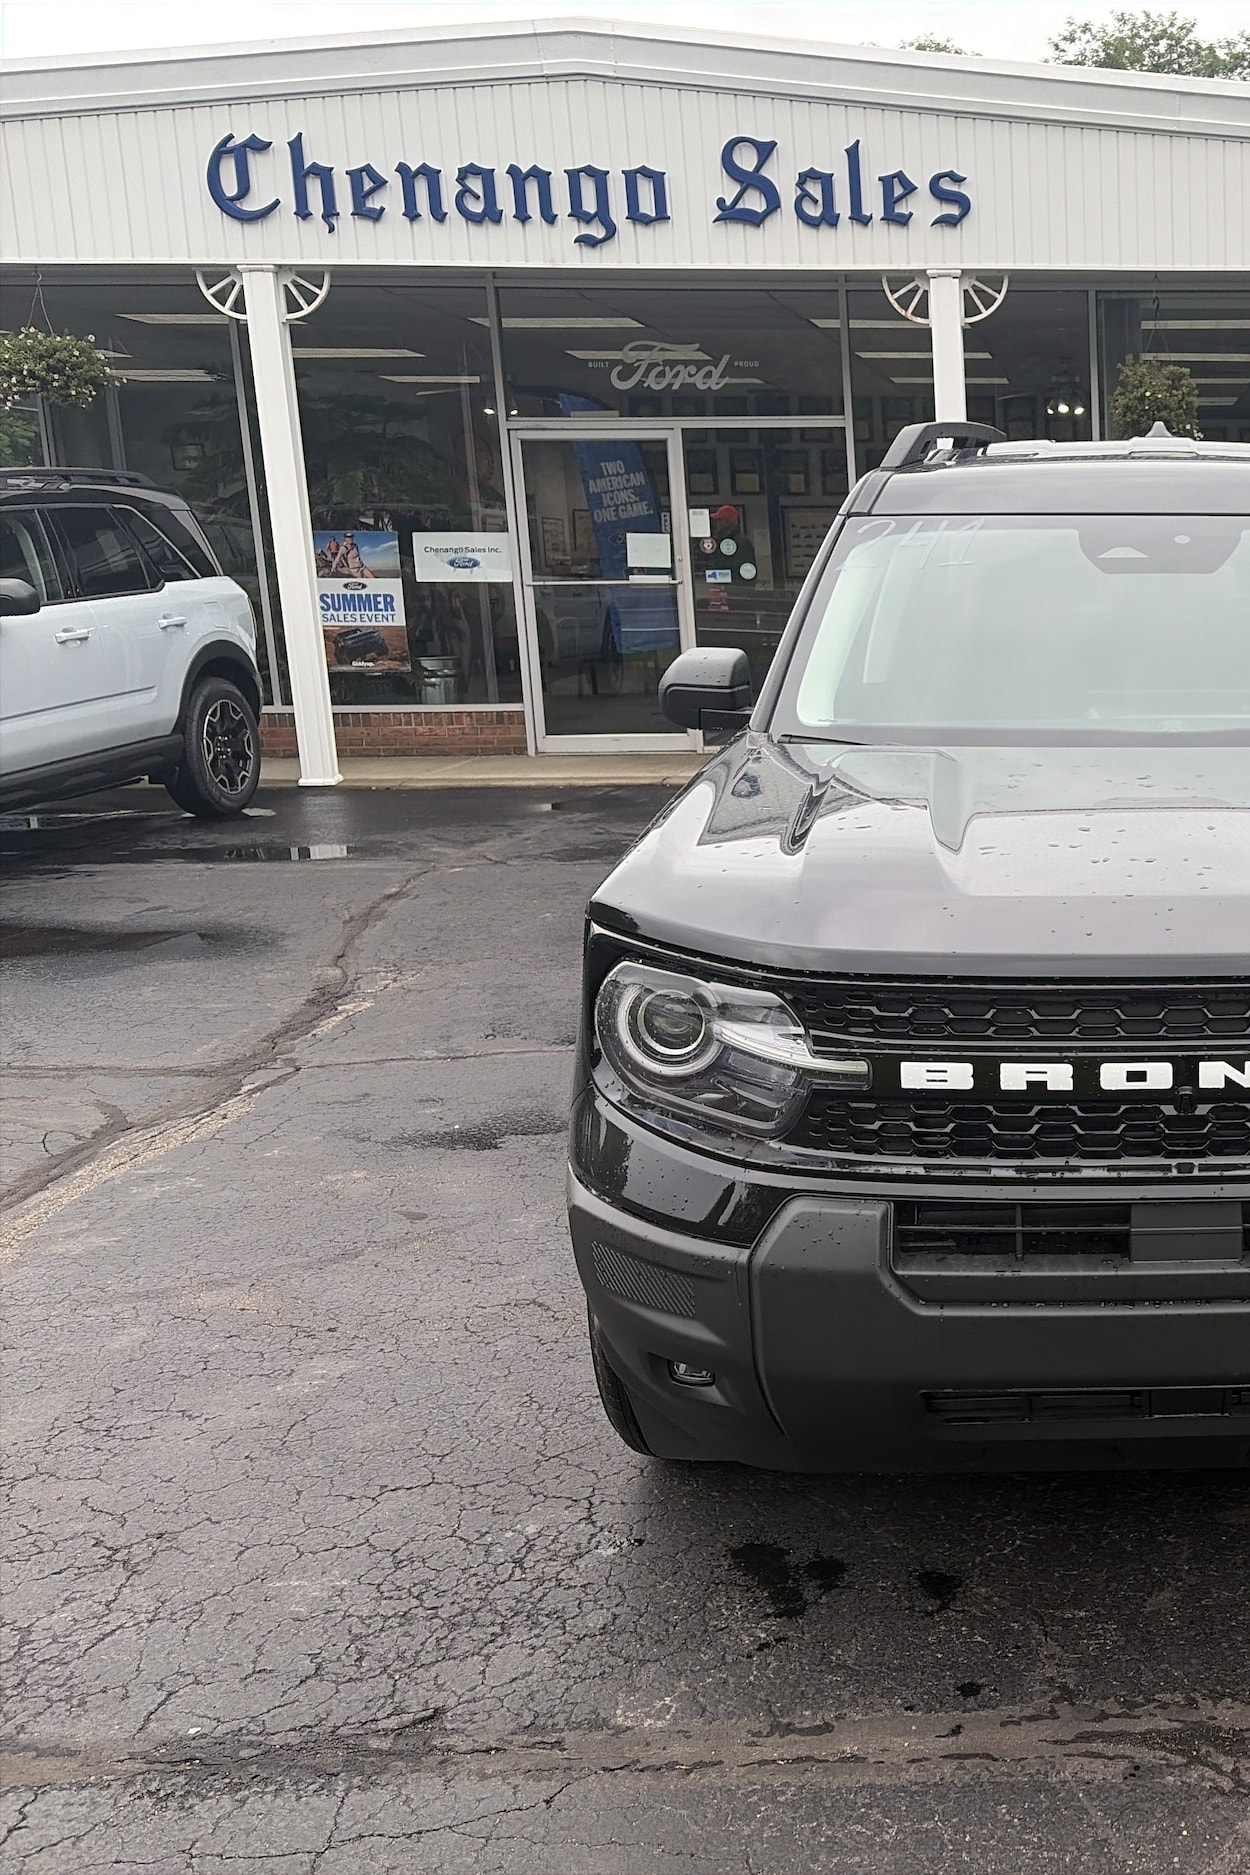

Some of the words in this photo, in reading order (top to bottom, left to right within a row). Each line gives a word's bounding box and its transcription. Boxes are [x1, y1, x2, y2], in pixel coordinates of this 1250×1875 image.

[206, 131, 671, 248] Chenango
[712, 136, 971, 228] Sales
[611, 340, 731, 391] Ford
[734, 360, 760, 368] PROUD
[600, 460, 625, 476] TWO
[589, 471, 646, 494] AMERICAN
[601, 489, 640, 507] ICONS.
[594, 507, 618, 523] ONE
[619, 501, 654, 519] GAME.
[424, 545, 464, 555] Chenango
[465, 545, 486, 553] Sales
[487, 545, 502, 553] Inc.
[319, 593, 395, 613] SUMMER
[322, 613, 357, 623] SALES
[359, 613, 396, 623] EVENT
